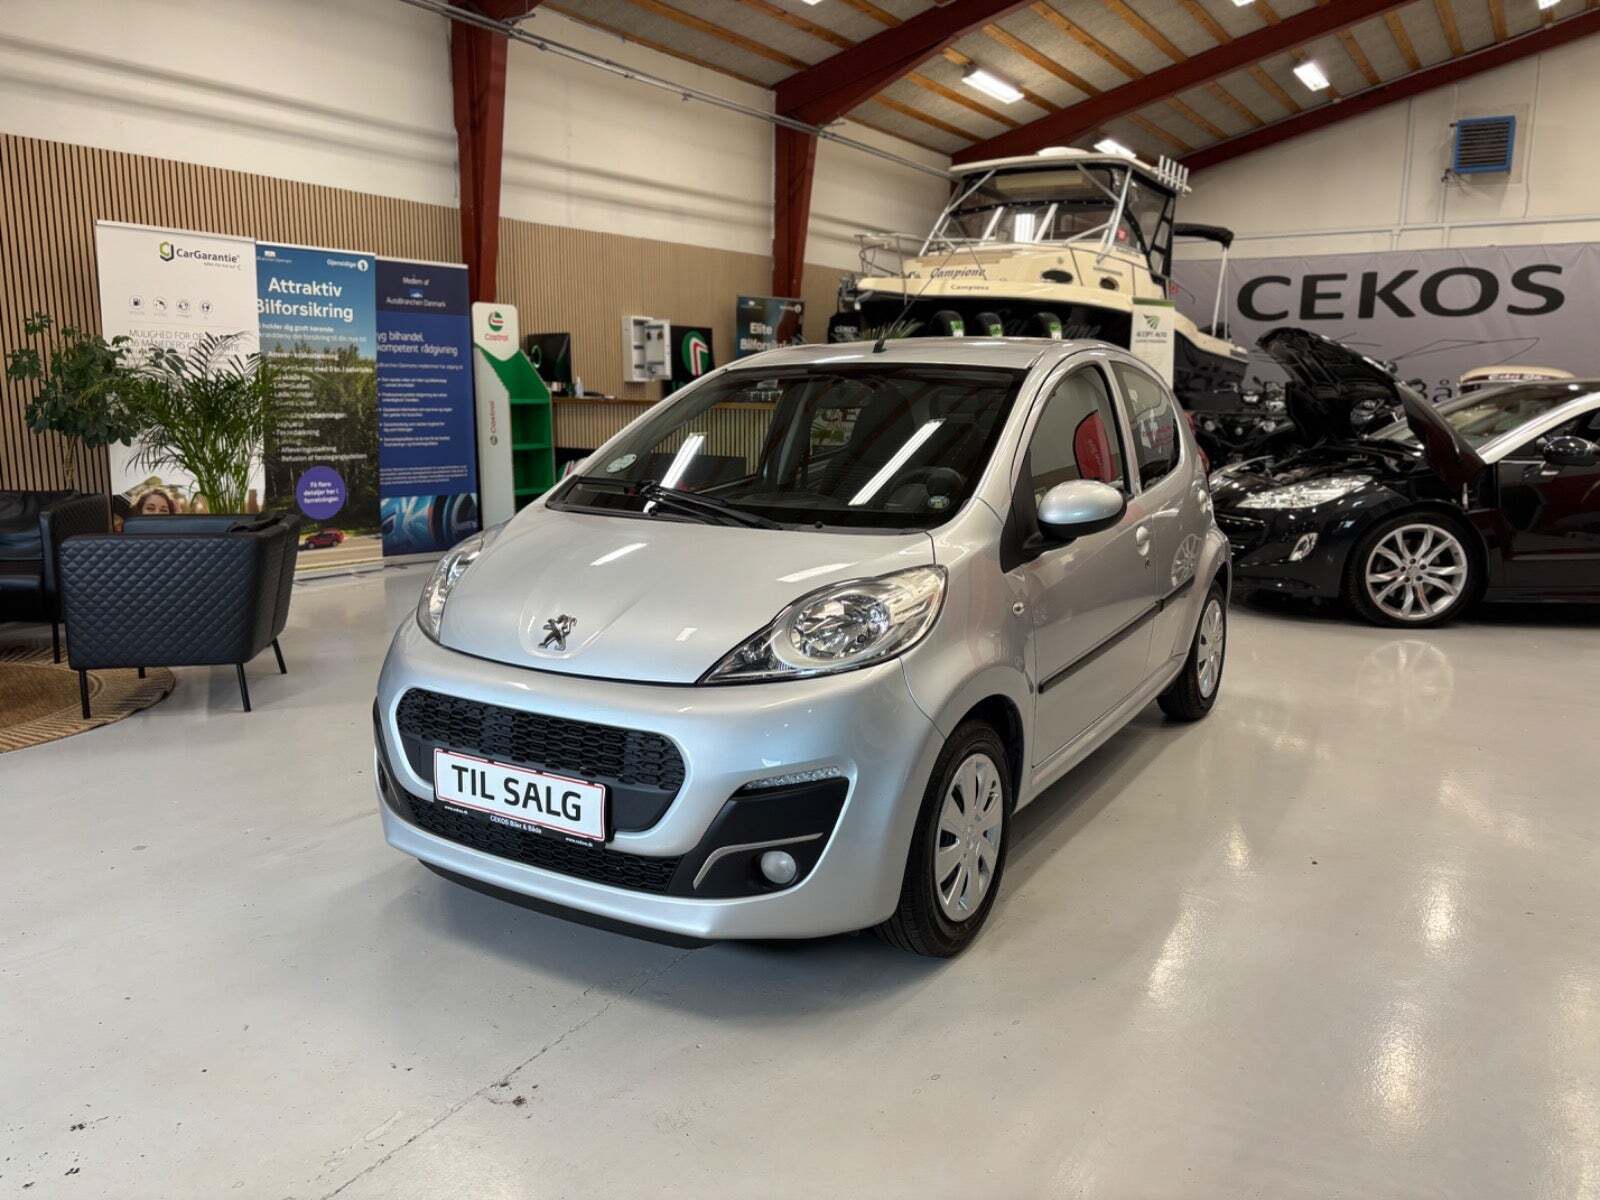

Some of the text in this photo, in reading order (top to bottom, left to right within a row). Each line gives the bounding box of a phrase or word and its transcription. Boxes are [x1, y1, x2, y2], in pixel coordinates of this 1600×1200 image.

[176, 248, 238, 263] CarGarantie
[930, 267, 986, 280] Campione
[268, 277, 342, 297] Attraktiv
[1237, 264, 1566, 322] CEKOS
[256, 298, 354, 323] Bilforsikring
[750, 322, 773, 335] Elite
[484, 333, 509, 342] Castrol
[451, 764, 581, 822] TIL SALG
